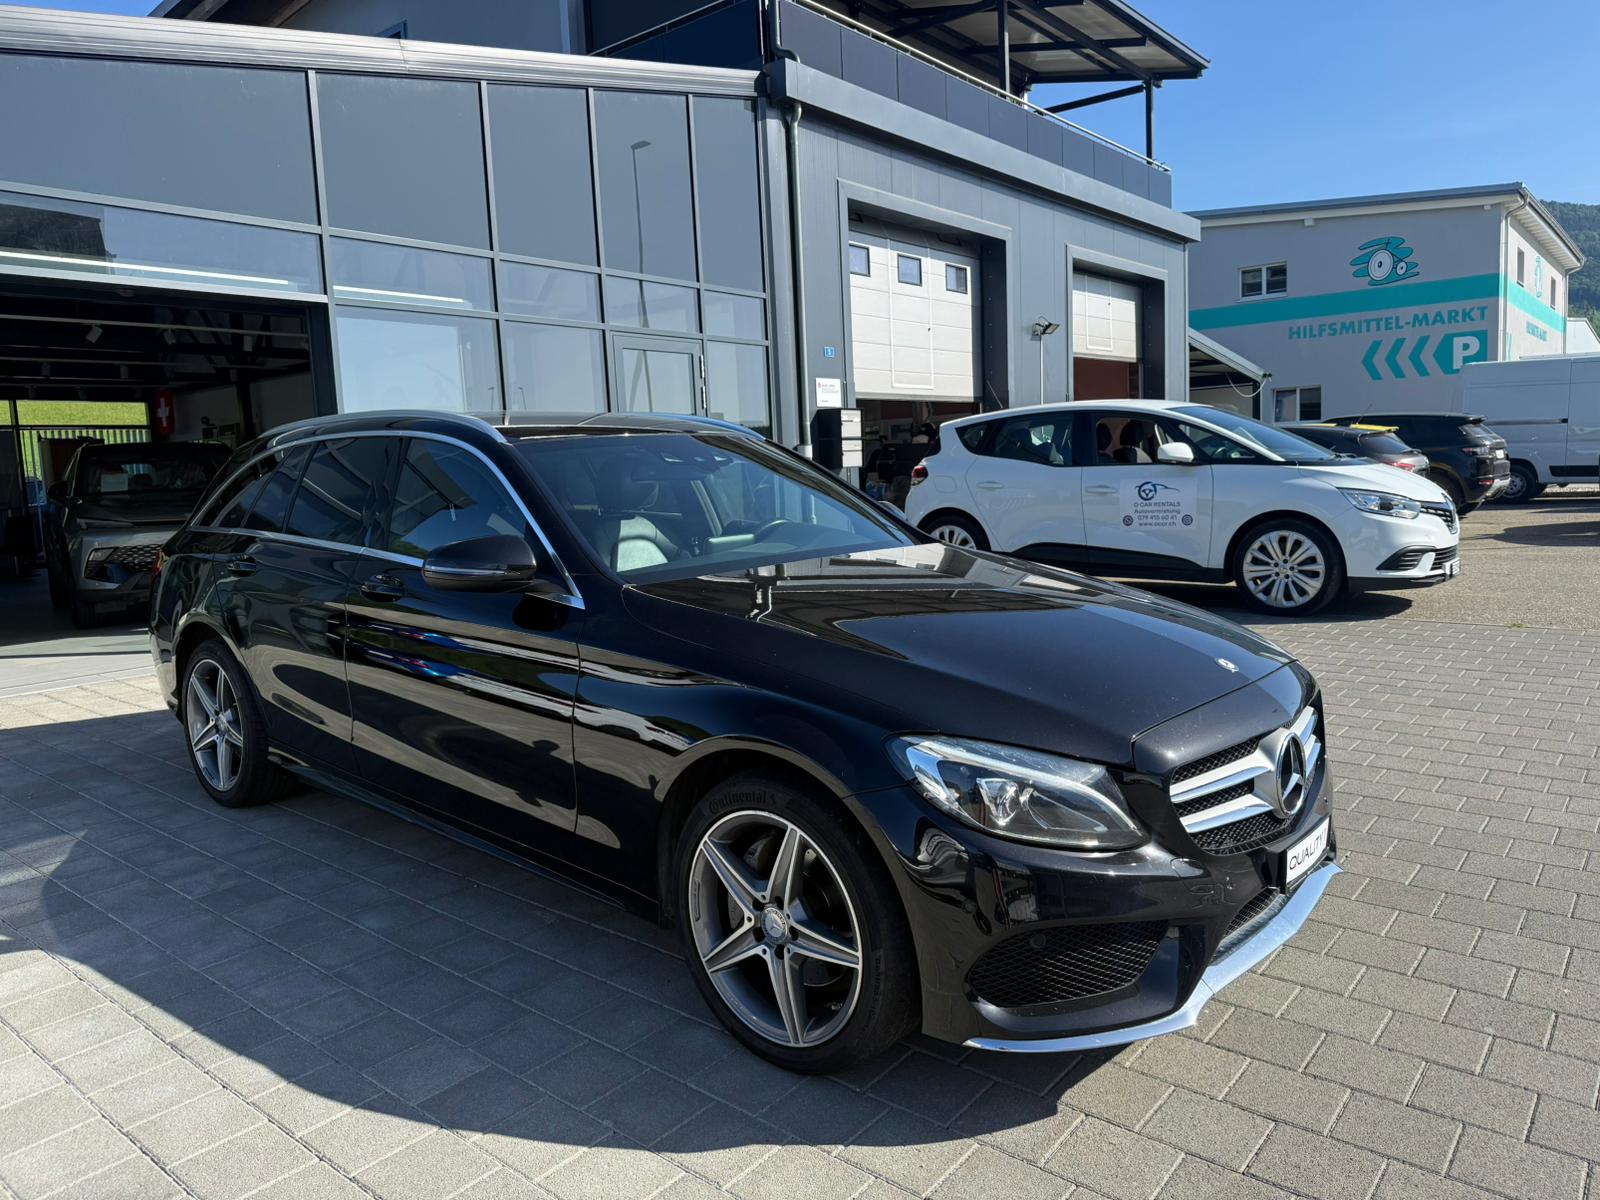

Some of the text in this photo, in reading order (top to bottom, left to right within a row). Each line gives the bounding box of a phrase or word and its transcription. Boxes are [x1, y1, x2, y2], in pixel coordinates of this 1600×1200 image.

[1288, 306, 1488, 340] HILFSMITTEL-MARKT
[1452, 336, 1480, 370] P
[708, 791, 767, 815] Continental
